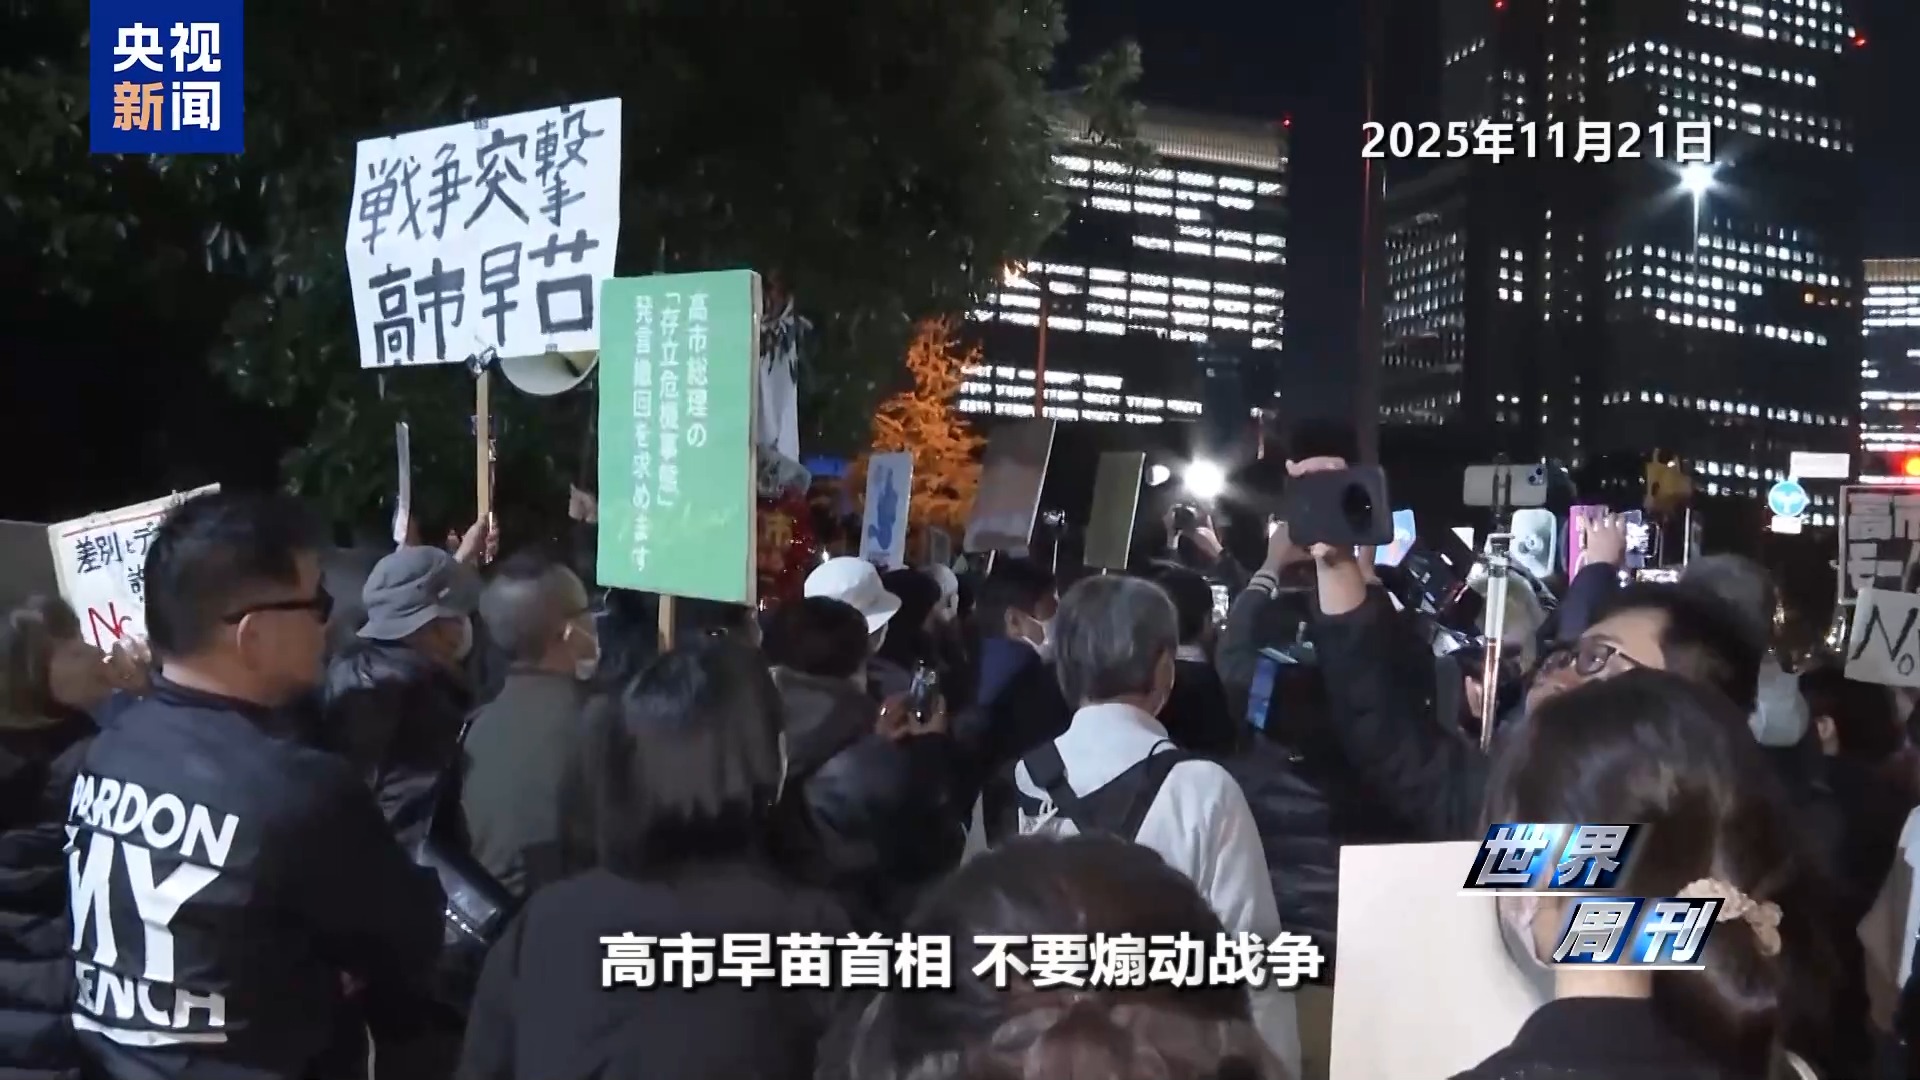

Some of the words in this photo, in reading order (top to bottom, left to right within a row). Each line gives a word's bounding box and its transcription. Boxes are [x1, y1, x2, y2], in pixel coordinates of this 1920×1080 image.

[359, 109, 605, 255] 戦争突撃
[687, 291, 710, 448] 高市総理の
[67, 772, 240, 868] PARDON
[62, 824, 222, 983] MY
